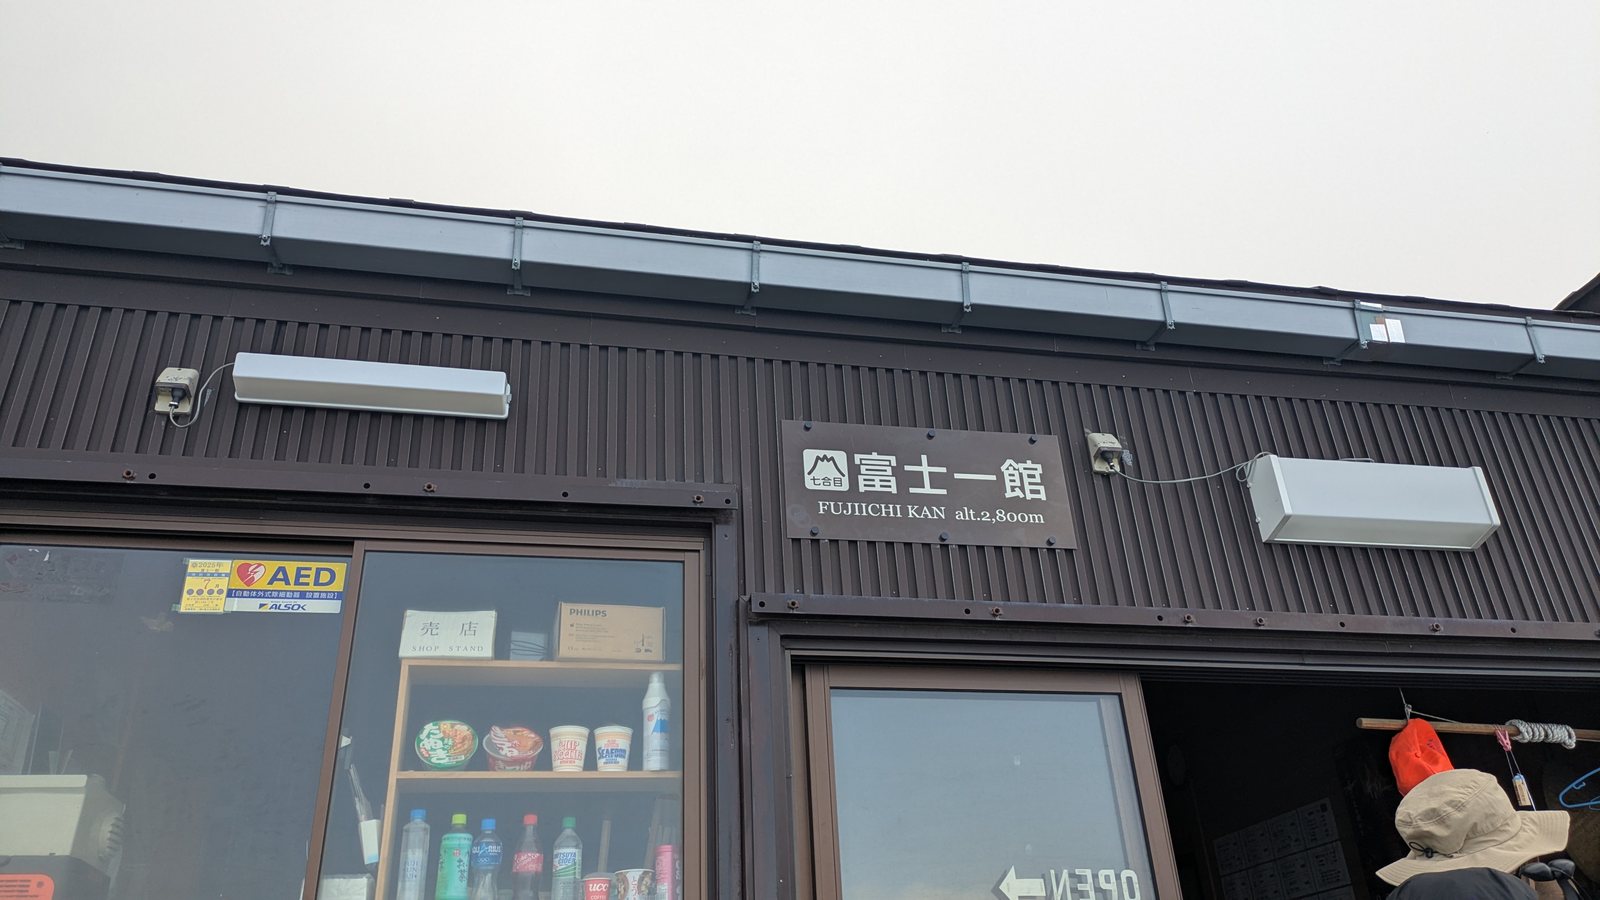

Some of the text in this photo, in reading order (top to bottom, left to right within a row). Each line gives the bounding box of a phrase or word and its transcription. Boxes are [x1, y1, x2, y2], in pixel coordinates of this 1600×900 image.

[809, 476, 843, 487] 七合目
[854, 452, 1047, 501] 富士一館
[818, 501, 1045, 524] FUJIICHI KAN alt.2,800m
[267, 566, 337, 587] AED
[269, 603, 307, 611] ALSOK
[569, 608, 608, 618] PHILIPS
